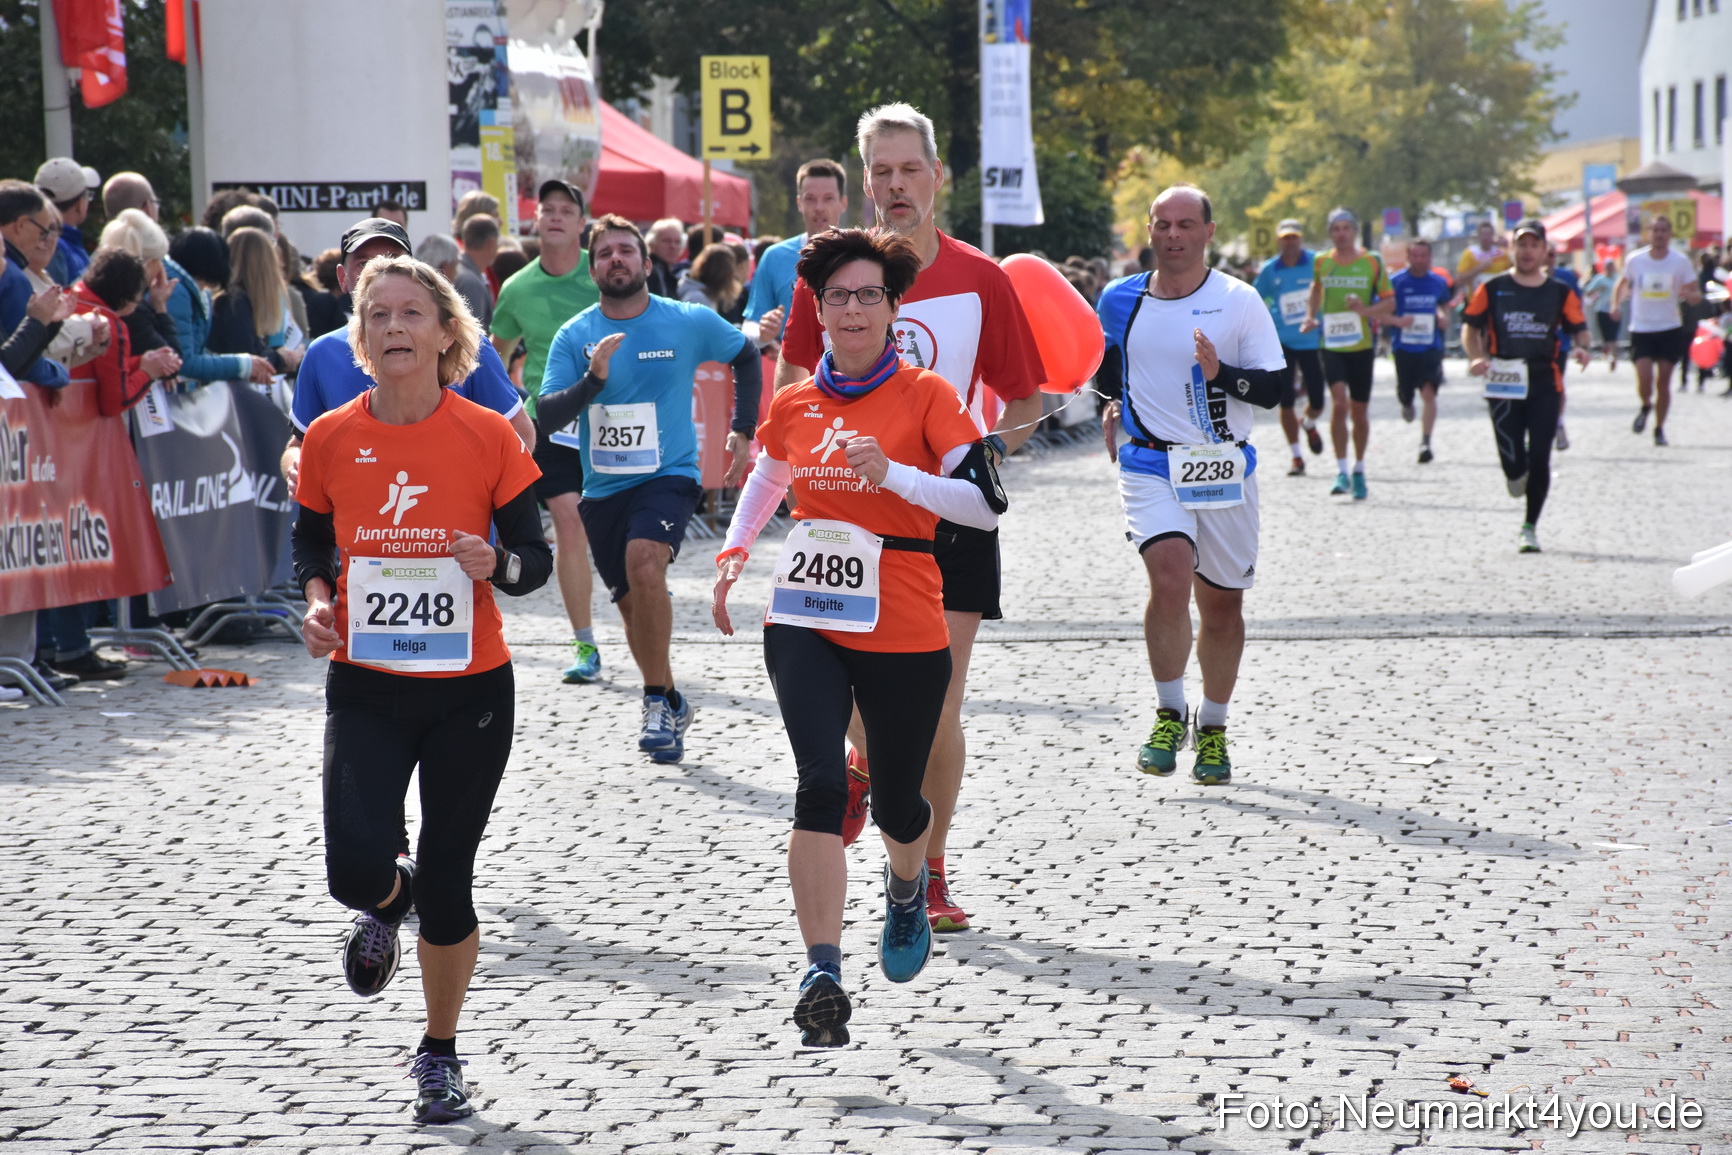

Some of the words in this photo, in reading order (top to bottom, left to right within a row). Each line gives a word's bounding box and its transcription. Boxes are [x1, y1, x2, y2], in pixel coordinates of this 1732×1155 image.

[709, 61, 761, 79] Block
[720, 88, 752, 136] B
[257, 184, 419, 210] MINI-Partlde
[1676, 210, 1691, 233] D
[1256, 228, 1271, 248] D
[637, 350, 675, 360] BOCK
[1490, 371, 1522, 383] 2228
[1185, 382, 1194, 407] WASTE
[598, 425, 646, 448] 2357
[355, 456, 377, 464] erima
[615, 454, 628, 463] Roi
[792, 465, 869, 482] funrunner
[1181, 460, 1235, 483] 2238
[151, 471, 228, 520] RAIL.ONE
[1191, 488, 1225, 499] Bernhard
[69, 501, 111, 560] Hits
[353, 525, 447, 544] funrunners
[816, 530, 851, 542] BOCK
[381, 540, 452, 554] neumark
[394, 567, 438, 578] BOCK
[787, 551, 864, 590] 2489
[366, 592, 455, 627] 2248
[804, 596, 845, 613] Brigitte
[393, 638, 427, 655] Helga
